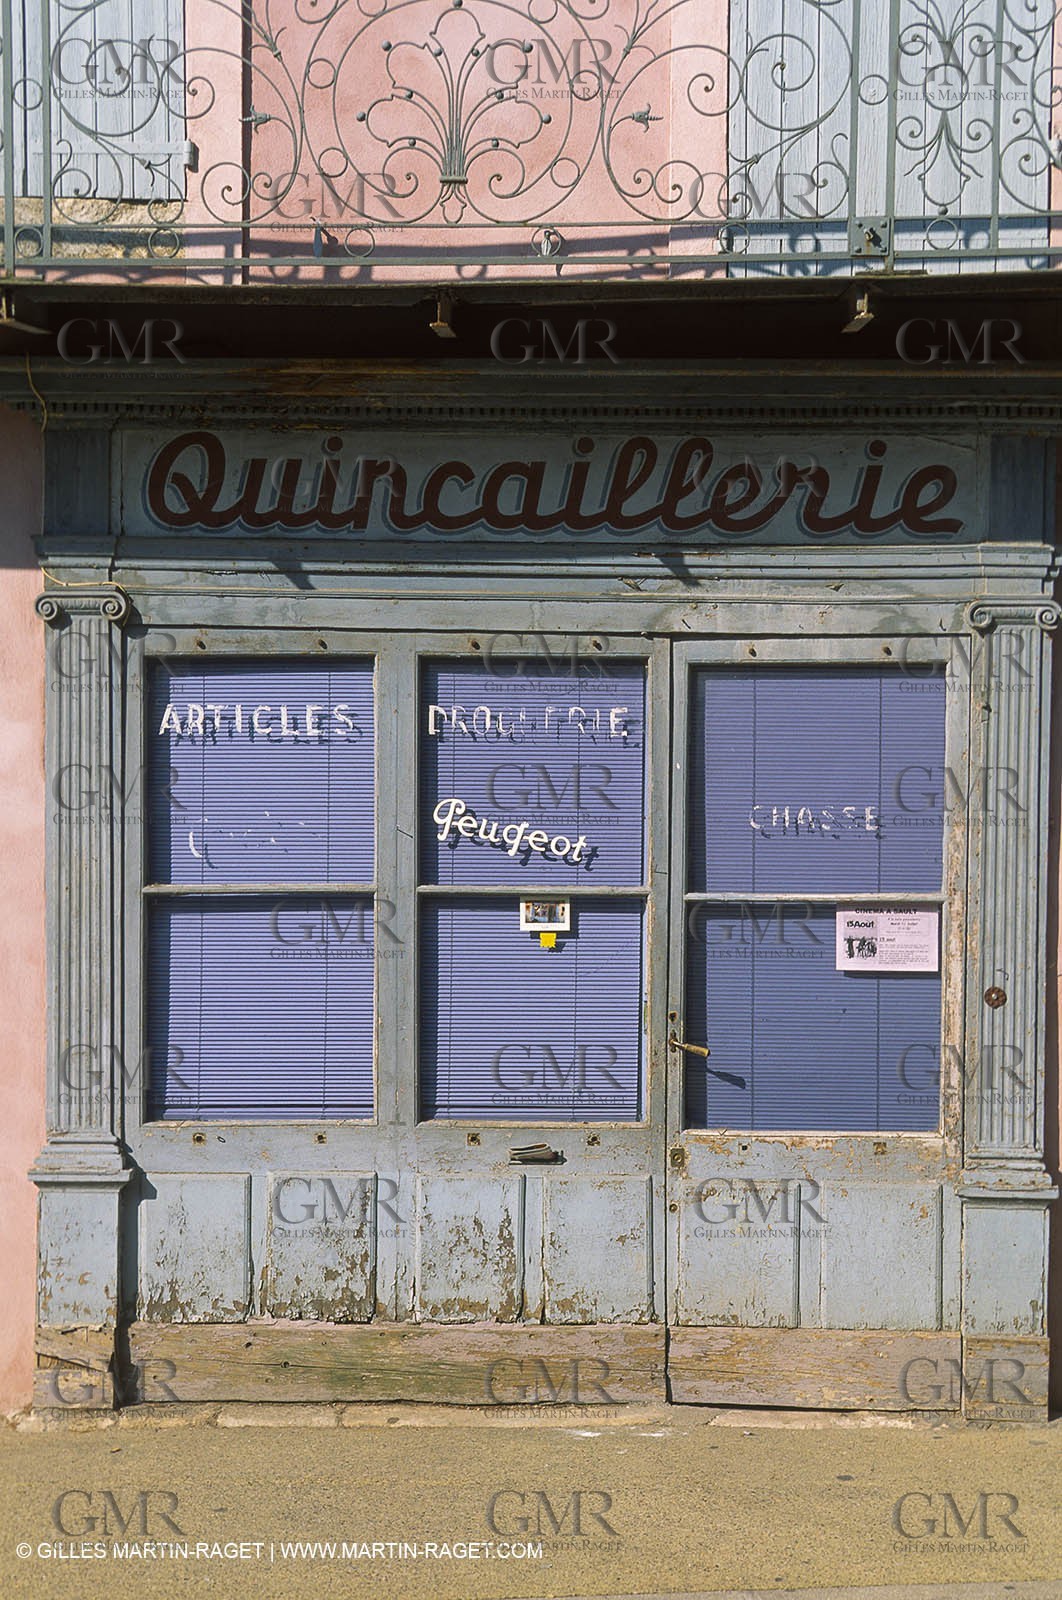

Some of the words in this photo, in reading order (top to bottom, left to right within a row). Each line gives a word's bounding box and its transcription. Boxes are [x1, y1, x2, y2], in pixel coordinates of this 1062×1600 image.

[145, 430, 964, 535] Quincaillerie
[158, 703, 355, 736] ARTICLES
[433, 798, 588, 862] Peugeot
[750, 804, 880, 832] CHASSE
